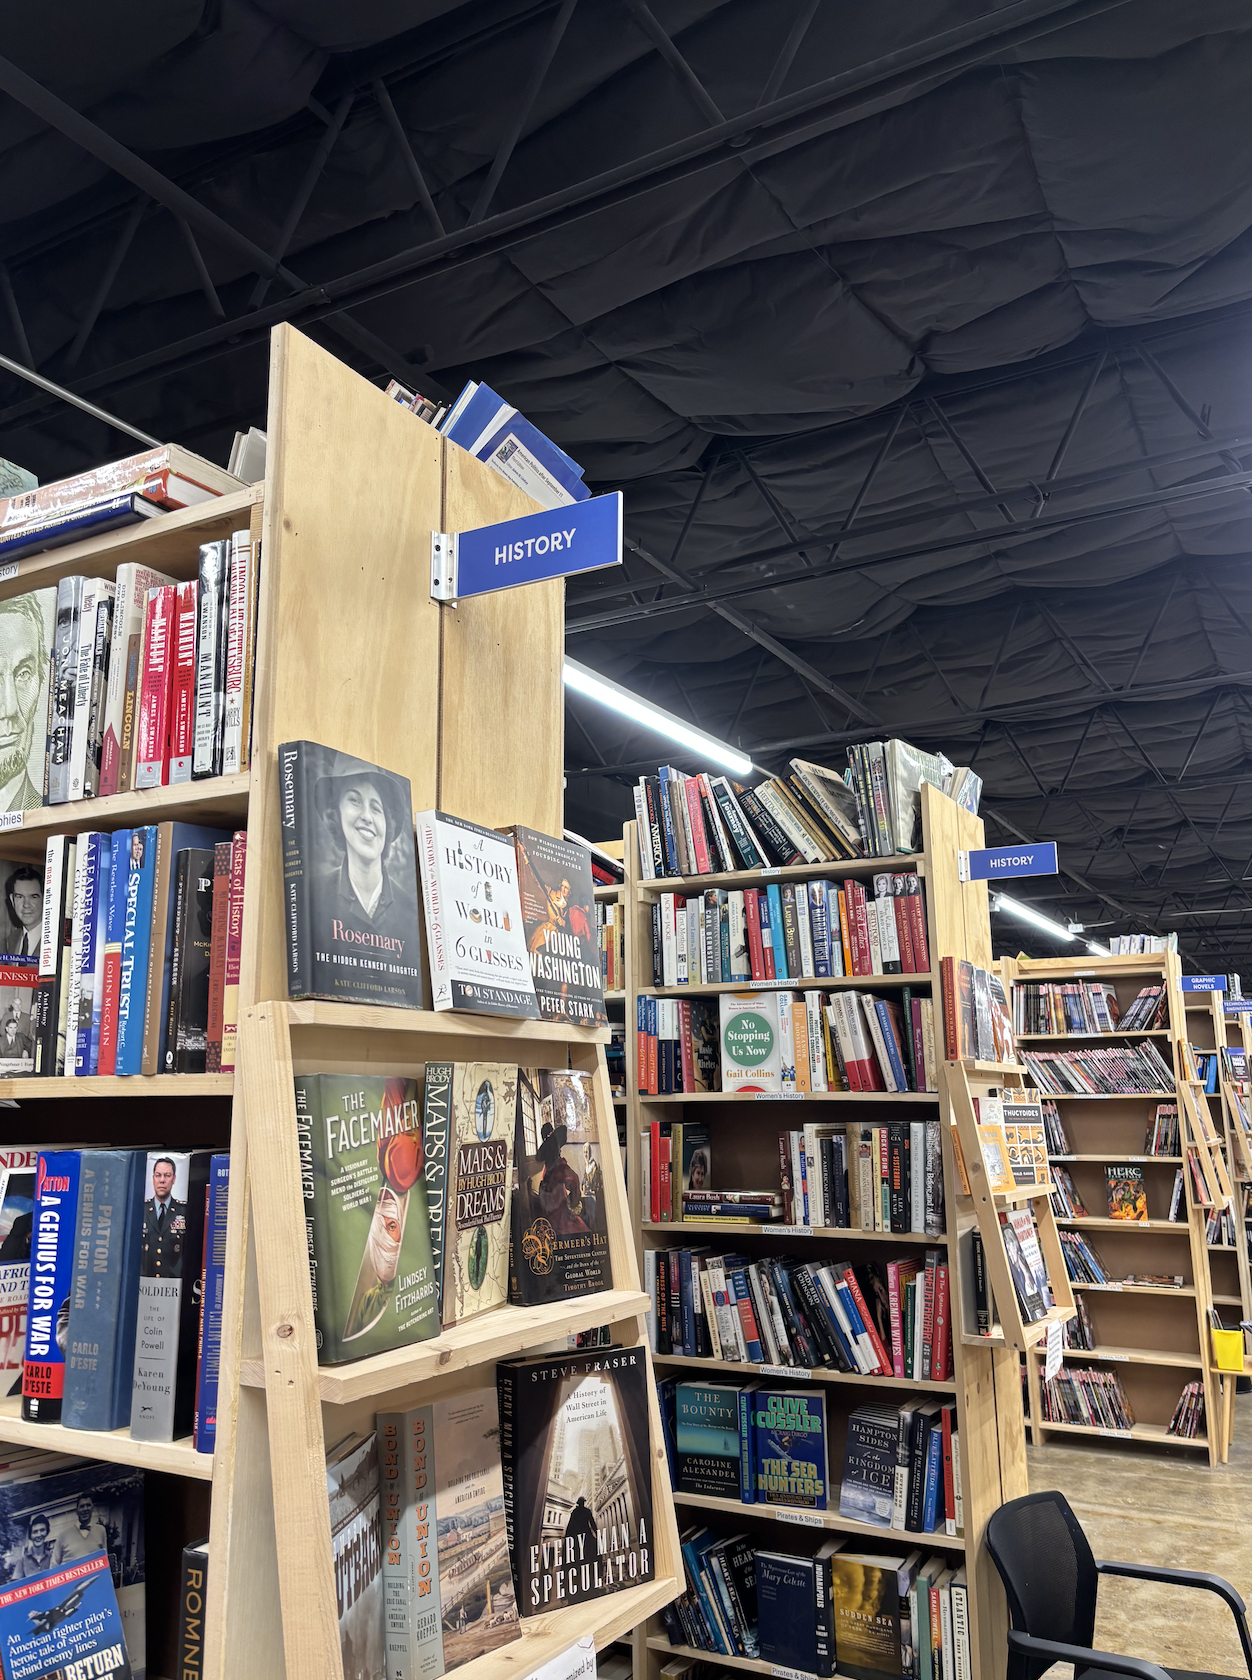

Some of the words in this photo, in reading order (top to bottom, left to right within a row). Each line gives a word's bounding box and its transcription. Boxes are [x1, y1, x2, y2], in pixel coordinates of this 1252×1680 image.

[495, 528, 576, 565] HISTORY
[149, 618, 166, 672] MANHUNT
[178, 611, 194, 667] MANHUNT
[61, 636, 70, 668] JON
[199, 653, 212, 718] MANHUNT
[56, 680, 69, 764] MEACHAM
[282, 750, 298, 830] Rosemary
[758, 790, 781, 819] HERITAGE
[46, 850, 55, 863] the
[651, 823, 662, 866] AMERICA
[990, 855, 1034, 868] HISTORY
[44, 908, 53, 944] invented
[122, 873, 140, 954] SPECIAL
[784, 905, 792, 928] LAURA
[331, 918, 406, 958] Rosemary
[543, 928, 581, 960] YOUNG
[787, 928, 795, 946] BUSH
[42, 947, 52, 968] fidel
[316, 952, 330, 962] THE
[332, 954, 358, 967] HIDDEN
[360, 958, 387, 972] KENNEDY
[389, 961, 418, 977] DAUGHTER
[528, 950, 601, 990] WASHINGTON
[105, 960, 114, 994] JOHN
[118, 956, 134, 1019] TRUST
[540, 996, 566, 1014] PETER
[568, 1000, 594, 1019] STARK
[102, 998, 113, 1046] McCAIN
[741, 1020, 755, 1030] No
[727, 1030, 771, 1042] Stopping
[732, 1046, 743, 1056] Us
[746, 1045, 767, 1056] Now
[426, 1067, 451, 1076] HUGH
[426, 1075, 451, 1083] BRODY
[726, 1070, 743, 1078] Gail
[745, 1069, 775, 1078] Collins
[342, 1091, 365, 1113] THE
[325, 1100, 419, 1159] FACEMAKER
[459, 1150, 494, 1176] MAPS
[494, 1146, 505, 1169] &
[1108, 1167, 1142, 1176] HERC
[42, 1195, 61, 1207] A
[456, 1186, 505, 1222] DREAMS
[792, 1227, 814, 1235] History
[38, 1210, 61, 1279] GENIUS
[139, 1286, 179, 1298] SOLDIER
[398, 1267, 428, 1292] LINDSEY
[796, 1273, 814, 1306] JOHNSON
[802, 1270, 812, 1286] LADY
[811, 1287, 820, 1304] BIRD
[847, 1275, 862, 1303] DIANA
[924, 1267, 934, 1302] AMELIA
[34, 1280, 56, 1311] FOR
[395, 1282, 434, 1314] FITZHARRIS
[889, 1291, 900, 1328] KREMLIN
[29, 1316, 50, 1356] WAR
[144, 1326, 163, 1337] Colin
[923, 1303, 934, 1344] EARHART
[142, 1340, 164, 1350] Powell
[891, 1329, 901, 1356] WIVES
[26, 1364, 52, 1379] CARLO
[531, 1365, 578, 1382] STEVE
[585, 1355, 637, 1373] FRASER
[760, 1367, 788, 1375] Women's
[789, 1369, 810, 1377] History
[566, 1402, 579, 1412] Wall
[581, 1400, 599, 1410] Street
[572, 1389, 598, 1401] History
[694, 1392, 721, 1403] THE
[767, 1396, 808, 1415] CLIVE
[566, 1411, 595, 1424] American
[596, 1408, 607, 1417] Life
[681, 1405, 734, 1418] BOUNTY
[756, 1410, 822, 1433] CUSSLER
[852, 1424, 898, 1440] HAMPTON
[859, 1435, 889, 1448] SIDES
[682, 1466, 736, 1479] ALEXANDER
[687, 1458, 732, 1469] CAROLINE
[762, 1458, 789, 1476] THE
[791, 1461, 818, 1479] SEA
[848, 1456, 894, 1474] KINGDOM
[758, 1474, 824, 1496] HUNTERS
[862, 1468, 890, 1487] ICE
[777, 1511, 798, 1521] Pirates
[804, 1516, 822, 1525] Ships
[529, 1533, 586, 1574] EVERY
[596, 1521, 630, 1556] MAN
[638, 1517, 647, 1544] A
[0, 1594, 12, 1605] THE
[14, 1588, 26, 1600] NEW
[28, 1583, 45, 1595] YORK
[46, 1575, 65, 1588] TIMES
[66, 1560, 104, 1580] BESTSELLER
[531, 1548, 650, 1606] SPECULATOR
[762, 1569, 781, 1585] Mary
[783, 1574, 806, 1588] Celeste
[815, 1564, 824, 1608] INDIANAPOLIS
[840, 1608, 874, 1622] SUDDEN
[876, 1616, 893, 1627] SEA
[955, 1590, 965, 1636] ATLANTIC
[10, 1632, 51, 1657] American
[53, 1620, 83, 1642] fighter
[84, 1608, 112, 1630] pilot's
[931, 1614, 939, 1638] VOWELL
[7, 1634, 20, 1645] An
[11, 1650, 37, 1669] heroic
[39, 1644, 55, 1659] tale
[56, 1637, 67, 1650] of
[68, 1623, 104, 1646] survival
[12, 1661, 42, 1680] behind
[44, 1649, 74, 1668] enemy
[76, 1639, 97, 1655] lines
[64, 1644, 124, 1680] RETURN
